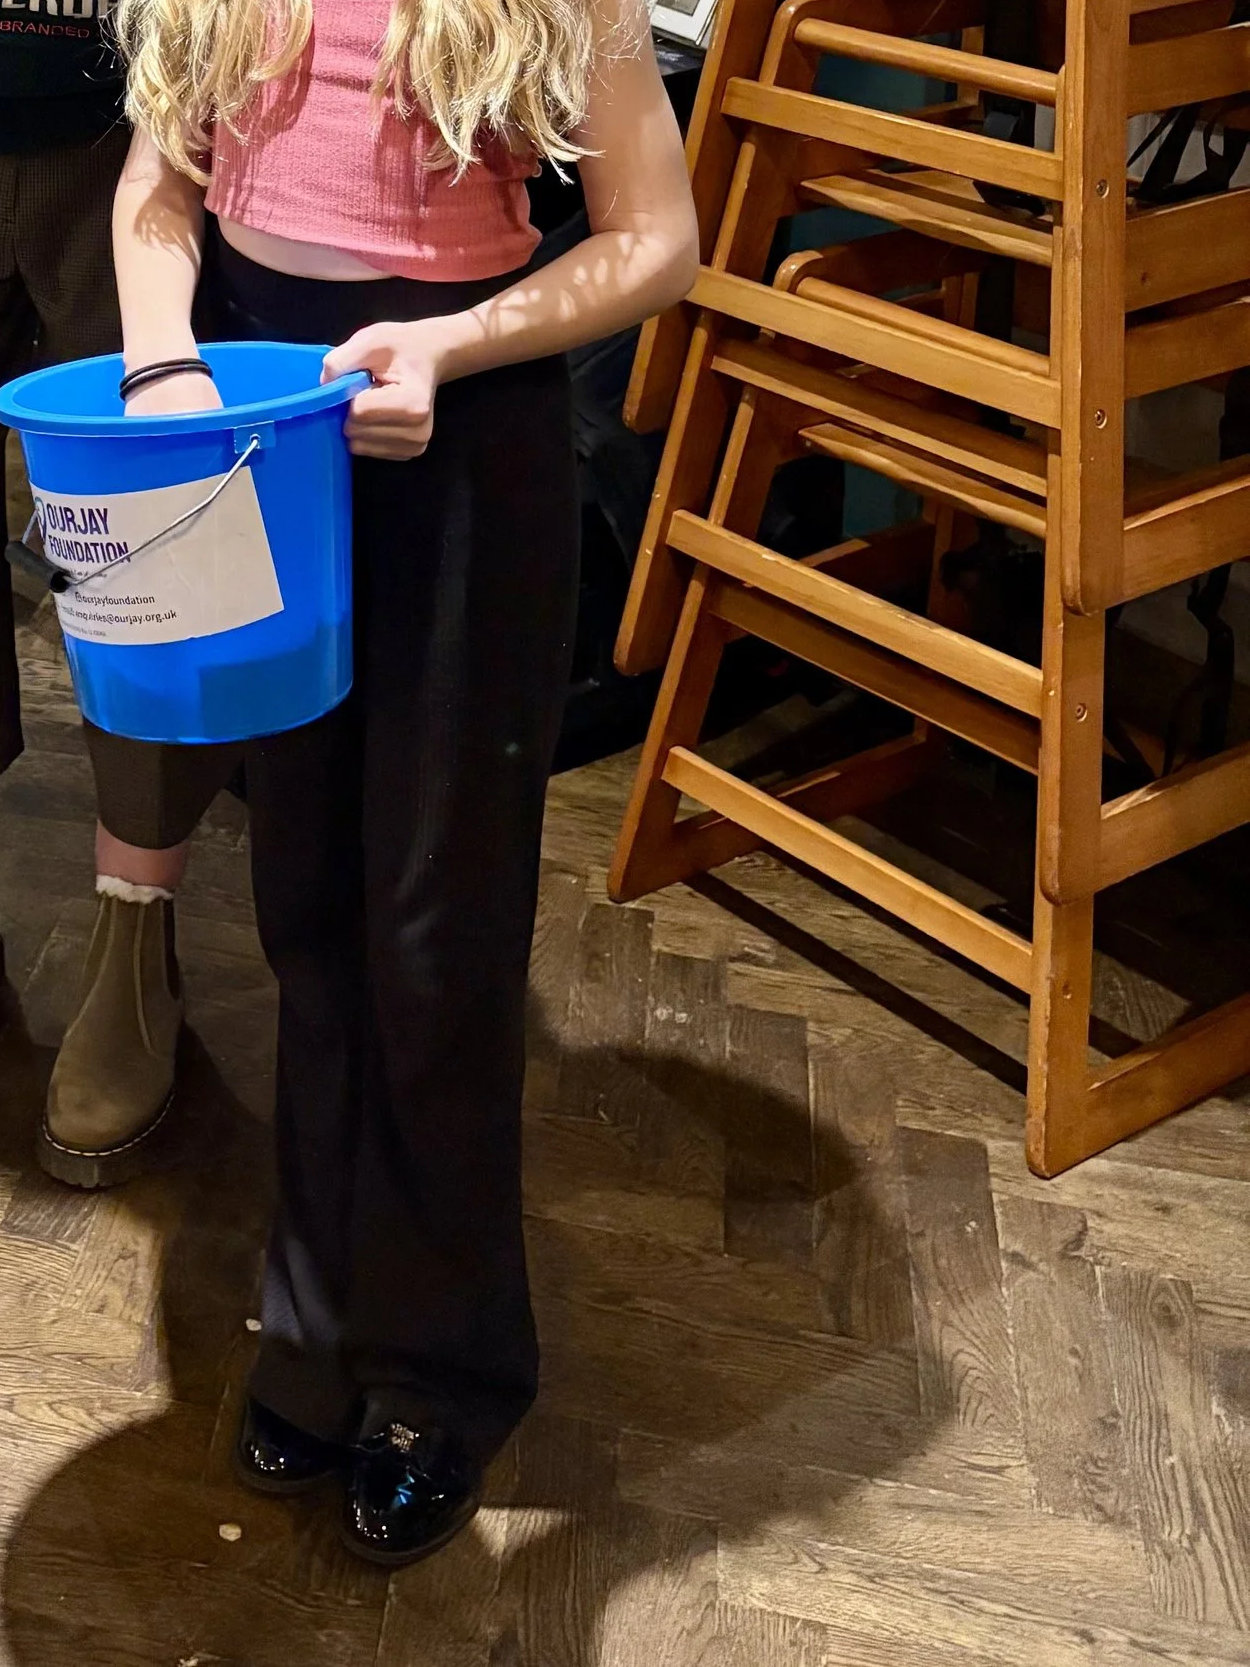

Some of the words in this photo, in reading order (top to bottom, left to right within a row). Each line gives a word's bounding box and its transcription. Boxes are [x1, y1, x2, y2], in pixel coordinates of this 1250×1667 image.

[0, 19, 90, 39] BRANDED
[46, 502, 110, 535] OURJAY
[48, 534, 131, 564] FOUNDATION
